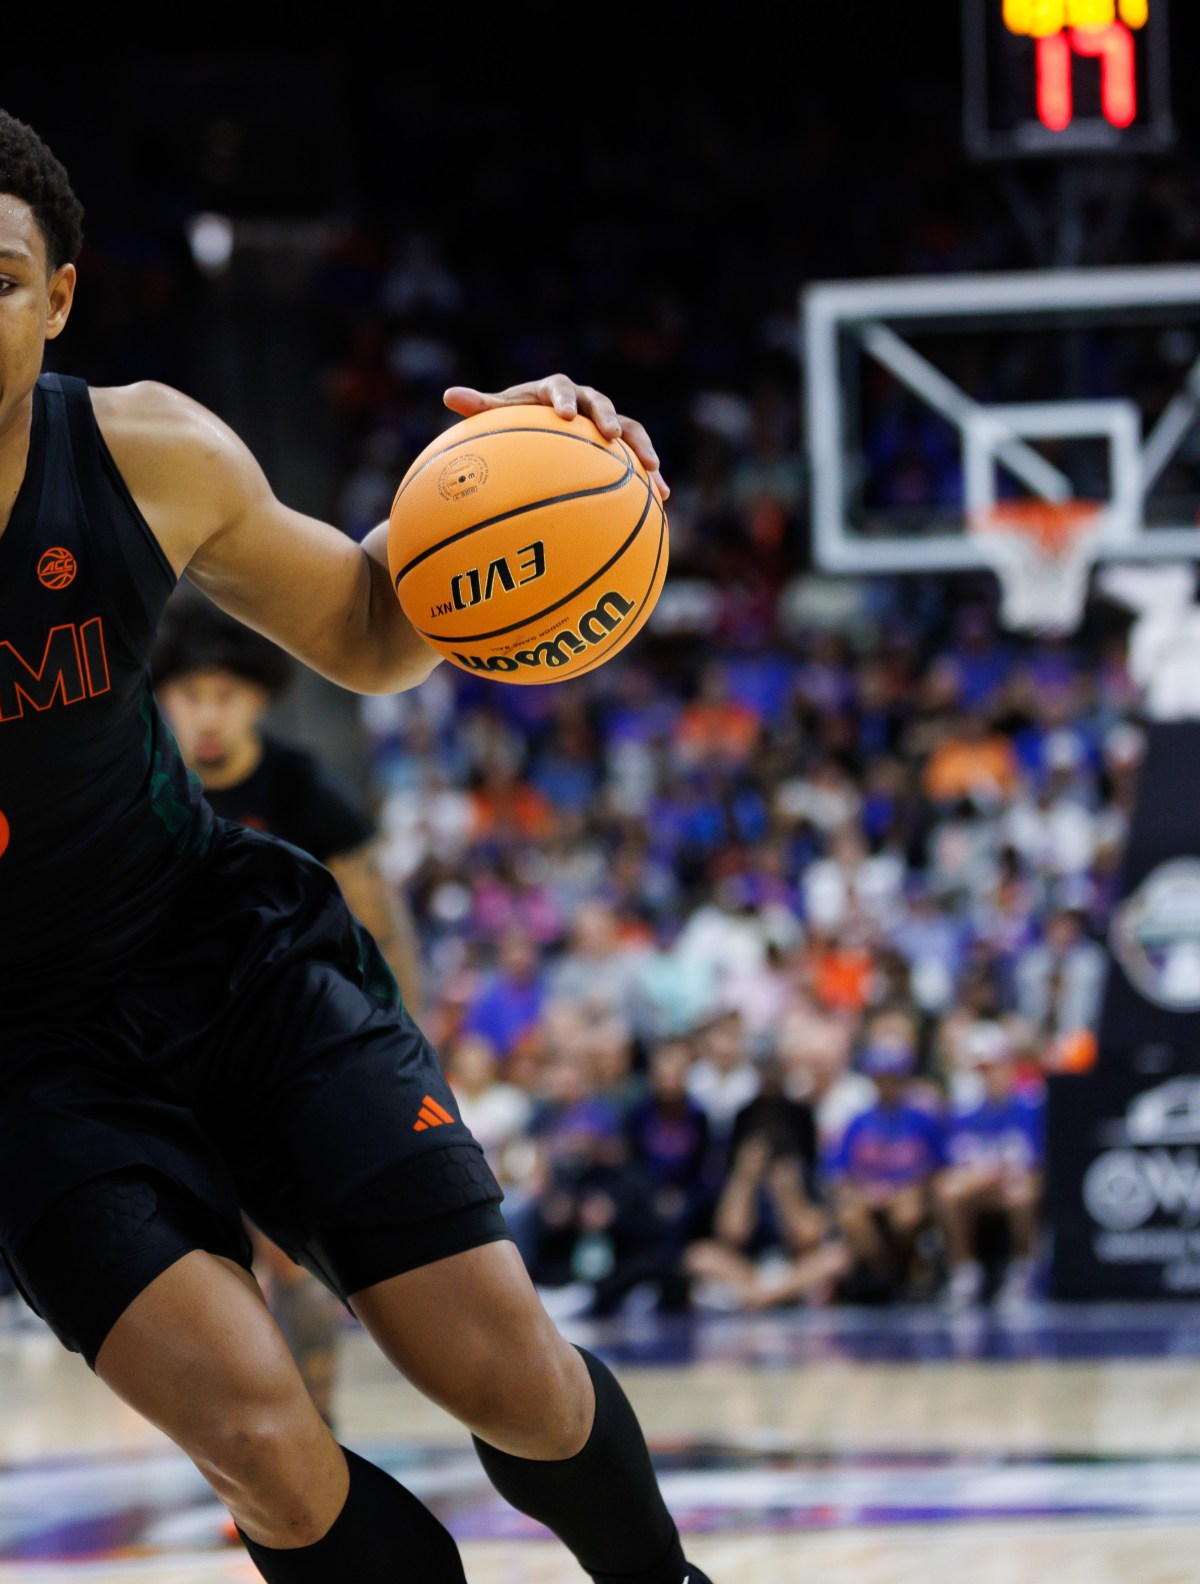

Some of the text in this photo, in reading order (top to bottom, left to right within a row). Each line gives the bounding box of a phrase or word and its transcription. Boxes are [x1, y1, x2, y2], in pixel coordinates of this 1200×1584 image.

[41, 558, 73, 574] ACC
[430, 539, 547, 618] EVO NXT
[451, 590, 636, 673] Wilson
